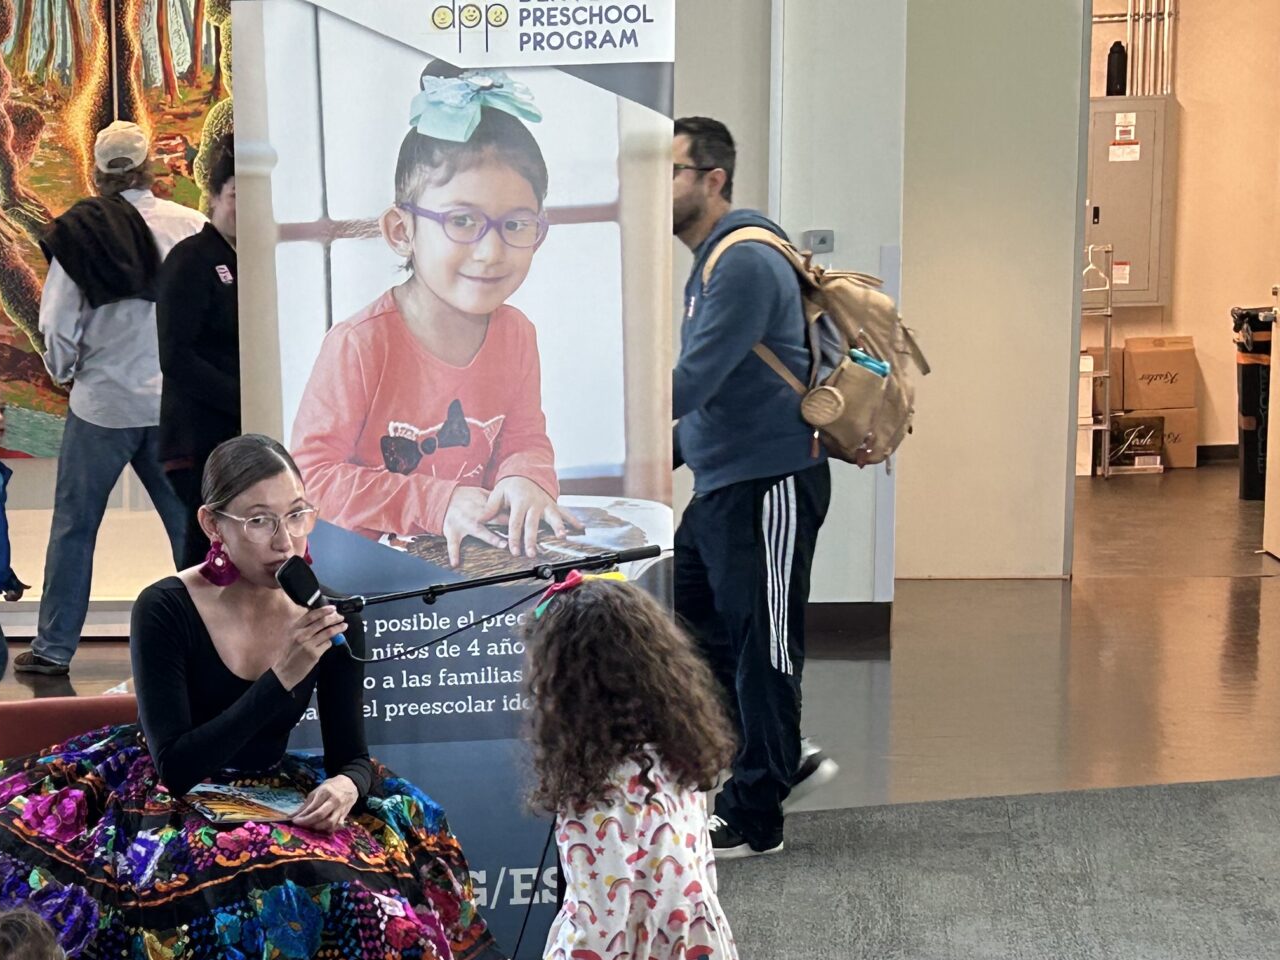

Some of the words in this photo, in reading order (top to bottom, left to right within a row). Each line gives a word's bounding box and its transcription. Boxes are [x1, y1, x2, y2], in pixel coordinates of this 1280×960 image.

[519, 4, 654, 27] PRESCHOOL
[519, 29, 639, 51] PROGRAM
[375, 612, 451, 638] posible
[457, 611, 474, 629] el
[372, 642, 429, 661] niños
[436, 640, 461, 657] de
[467, 638, 480, 656] 4
[382, 676, 395, 689] a
[401, 669, 432, 688] las
[438, 667, 524, 686] familias
[384, 695, 496, 722] preescolar
